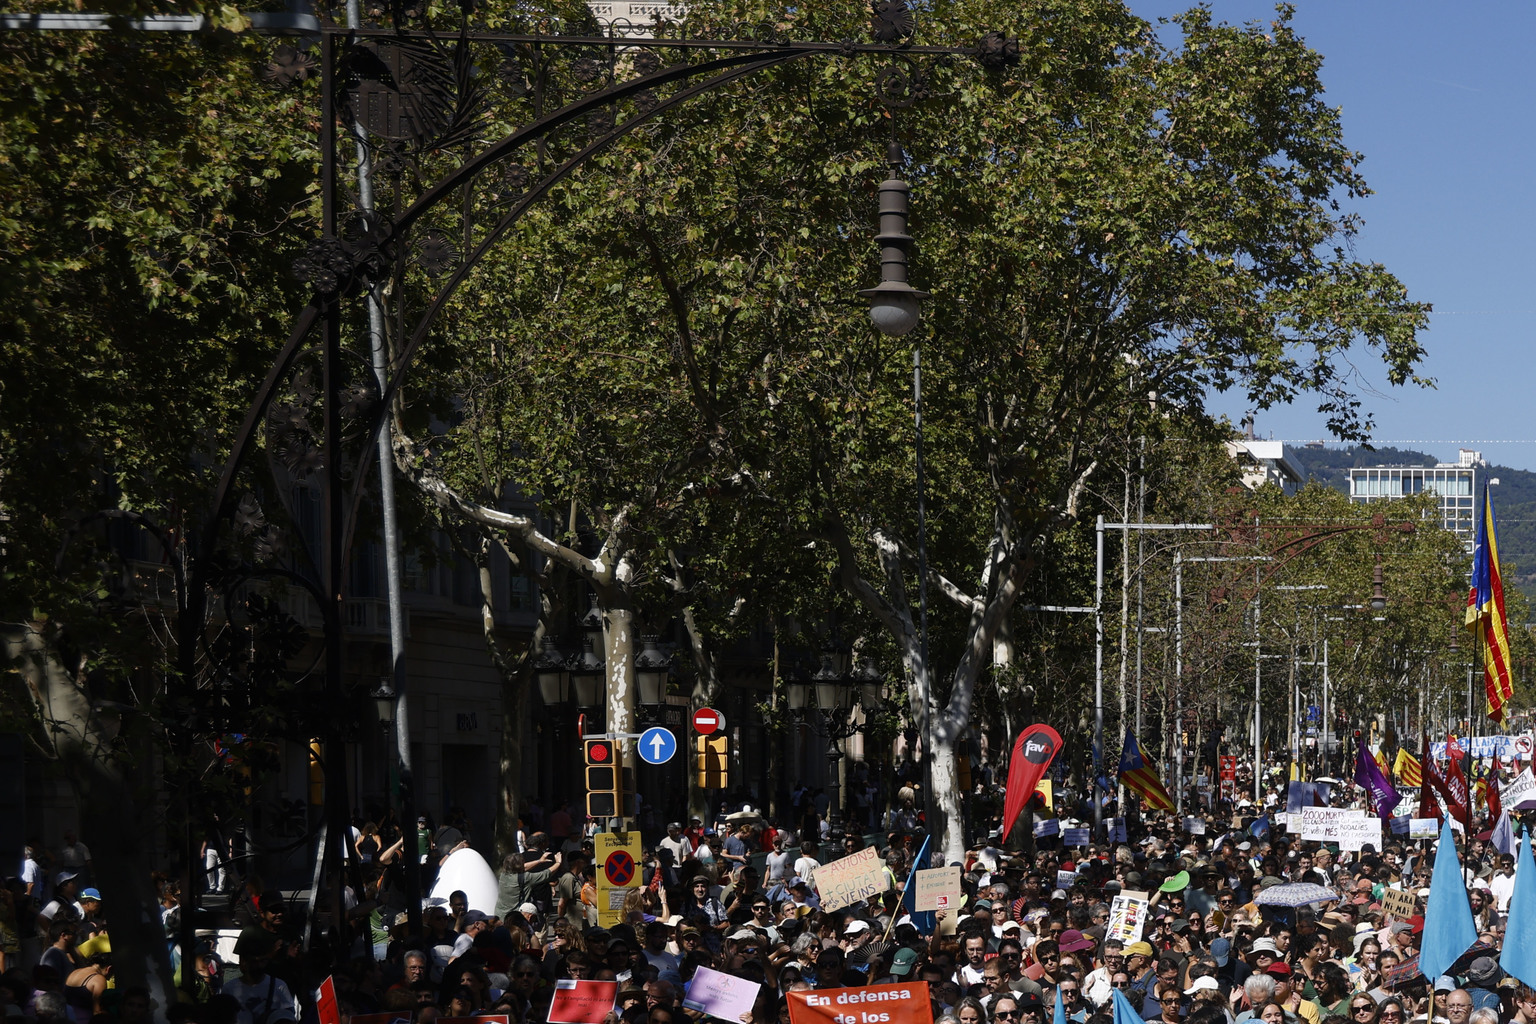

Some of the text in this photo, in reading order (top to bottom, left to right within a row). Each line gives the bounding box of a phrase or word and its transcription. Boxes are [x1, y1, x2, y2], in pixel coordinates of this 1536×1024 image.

[831, 848, 875, 873] AVIONS
[835, 870, 877, 895] CIUTAT
[1398, 894, 1413, 906] ARA
[806, 988, 911, 1008] En defensa
[862, 1010, 890, 1024] los
